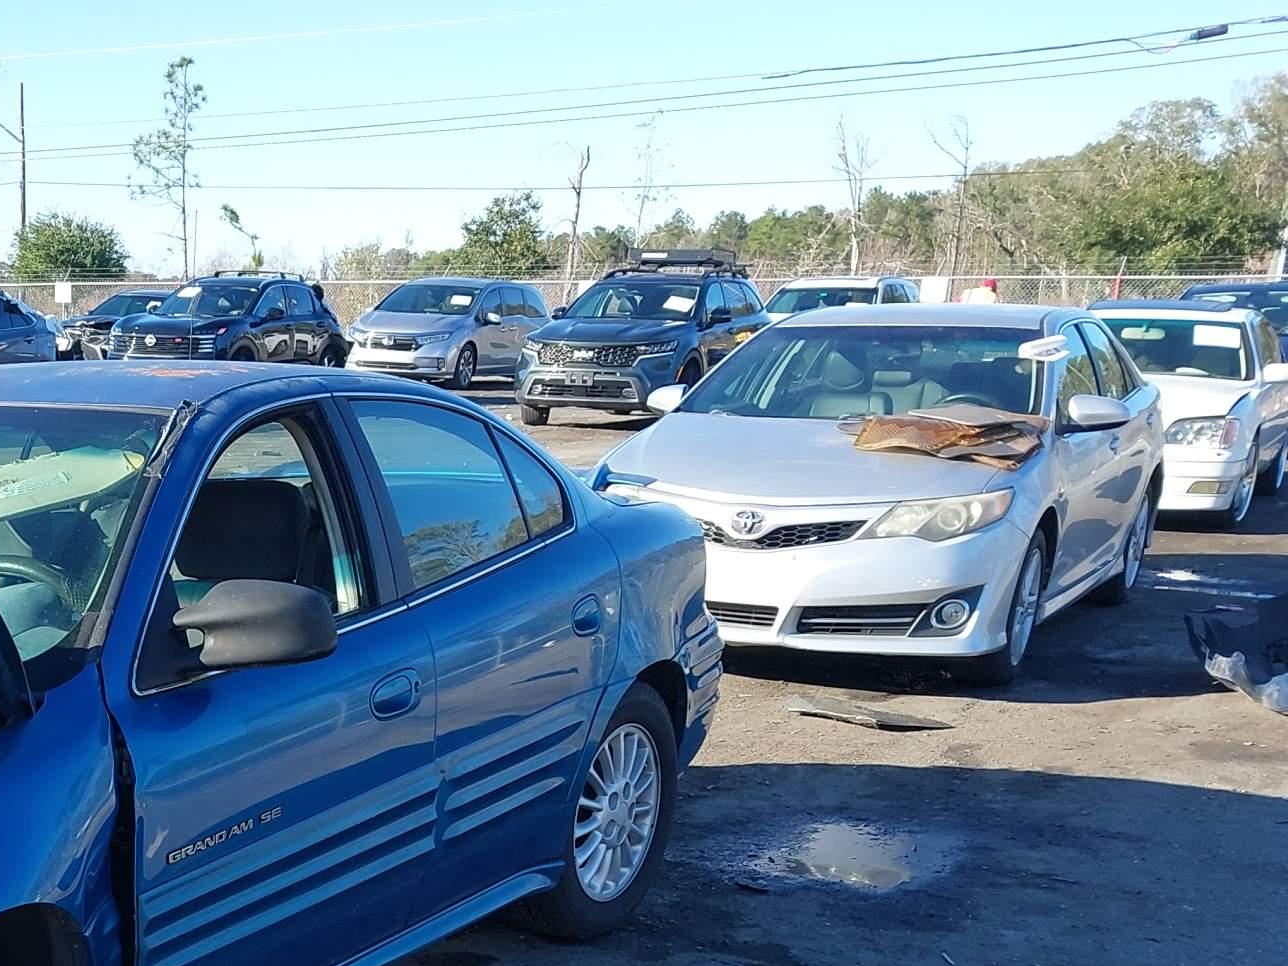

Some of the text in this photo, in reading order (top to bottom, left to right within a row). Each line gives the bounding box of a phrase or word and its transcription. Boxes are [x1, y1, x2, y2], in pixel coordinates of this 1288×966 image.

[167, 806, 282, 865] GRAND AM SE
